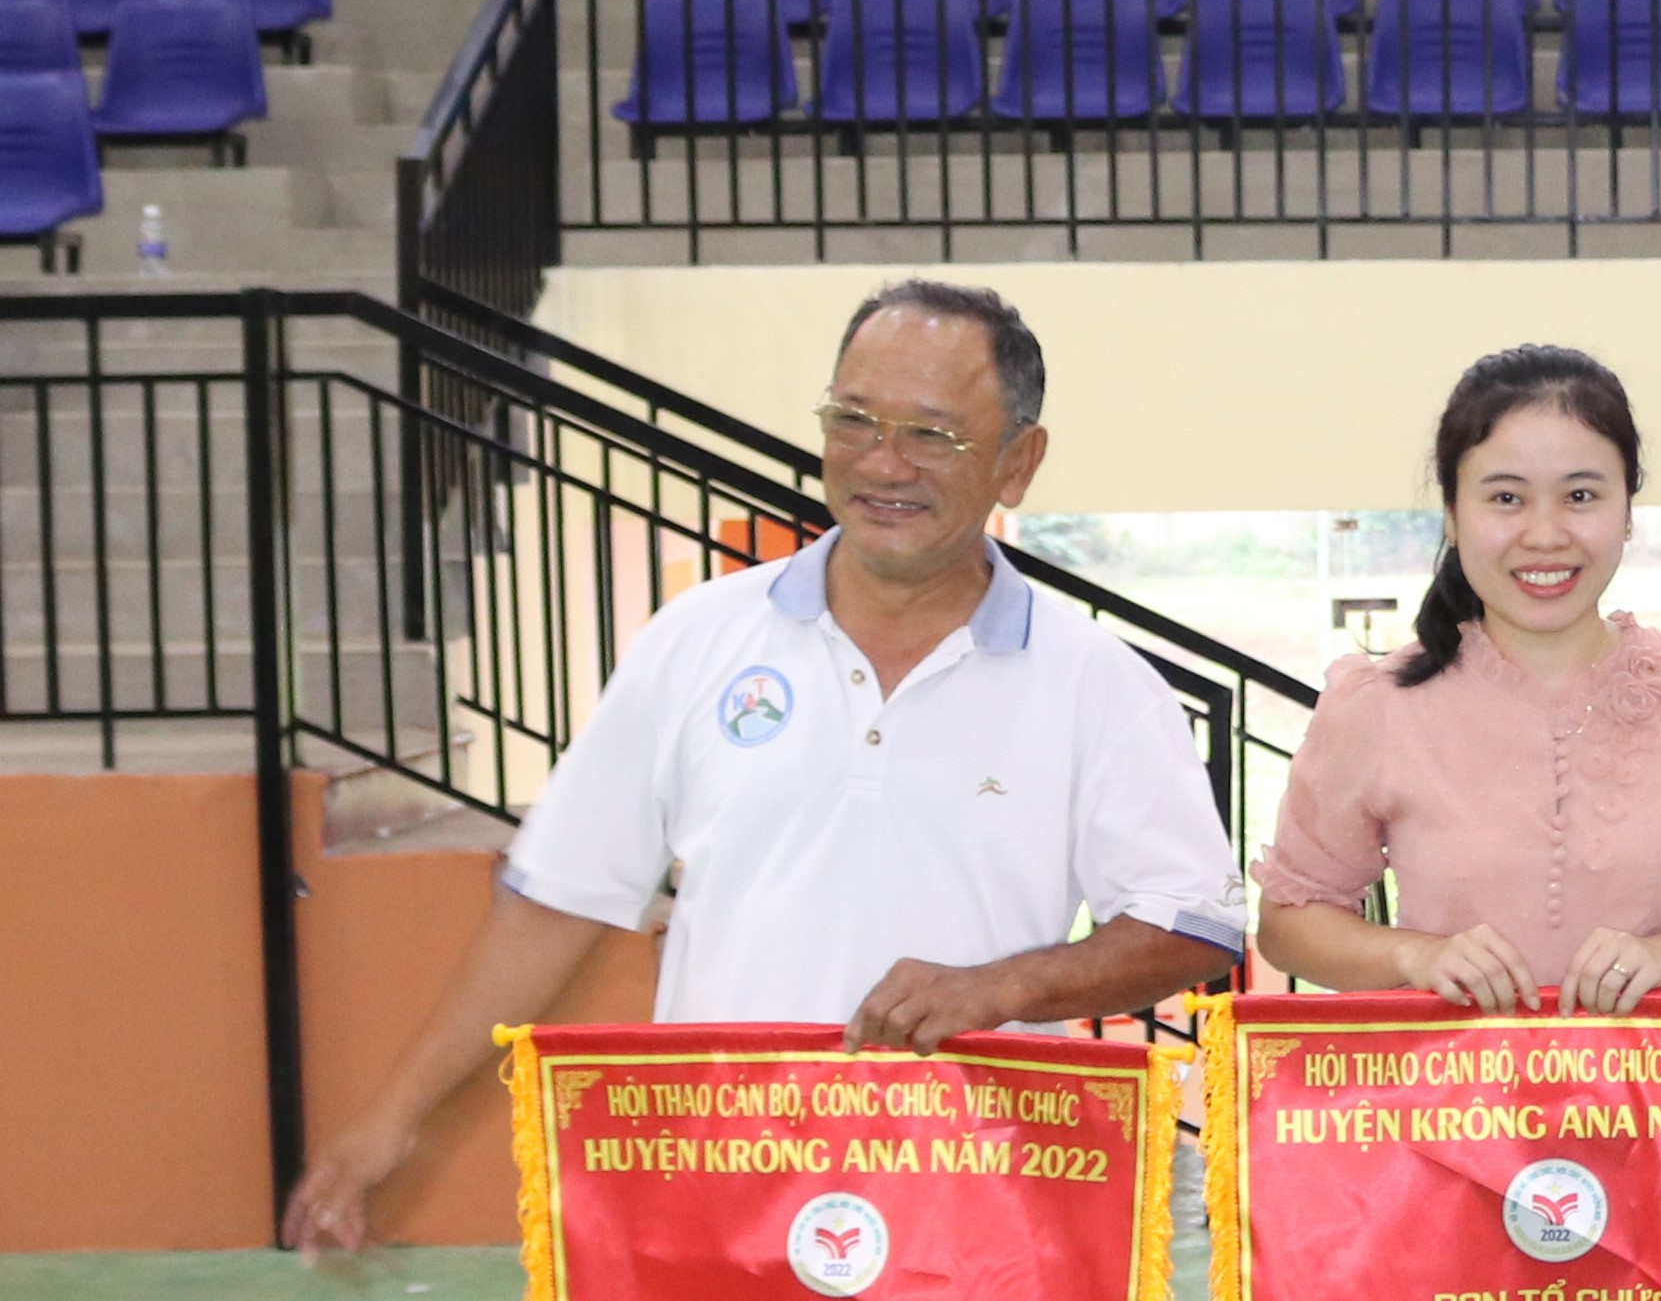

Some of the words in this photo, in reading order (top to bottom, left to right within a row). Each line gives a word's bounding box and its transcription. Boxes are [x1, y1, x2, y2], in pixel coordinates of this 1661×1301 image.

[1304, 1043, 1346, 1097] HỘI
[1353, 1051, 1418, 1087] THAO
[1424, 1041, 1474, 1086] CÁN
[1480, 1040, 1519, 1097] BỘ,
[1526, 1042, 1596, 1087] CÔNG
[607, 1075, 648, 1126] HỘI
[652, 1083, 711, 1118] THAO
[717, 1073, 765, 1117] CÁN
[768, 1075, 808, 1126] BỘ,
[811, 1074, 880, 1118] CÔNG
[885, 1072, 957, 1125] CHỨC,
[963, 1076, 1012, 1120] VIÊN
[1018, 1083, 1081, 1127] CHỨC
[1276, 1099, 1400, 1152] HUYỆN
[1410, 1097, 1546, 1142] KRÔNG
[1557, 1106, 1638, 1142] ANA
[584, 1129, 697, 1181] HUYỆN
[704, 1130, 831, 1173] KRÔNG
[842, 1139, 920, 1174] ANA
[930, 1132, 1010, 1176] NĂM
[1020, 1142, 1109, 1183] 2022
[1541, 1229, 1570, 1242] 2022
